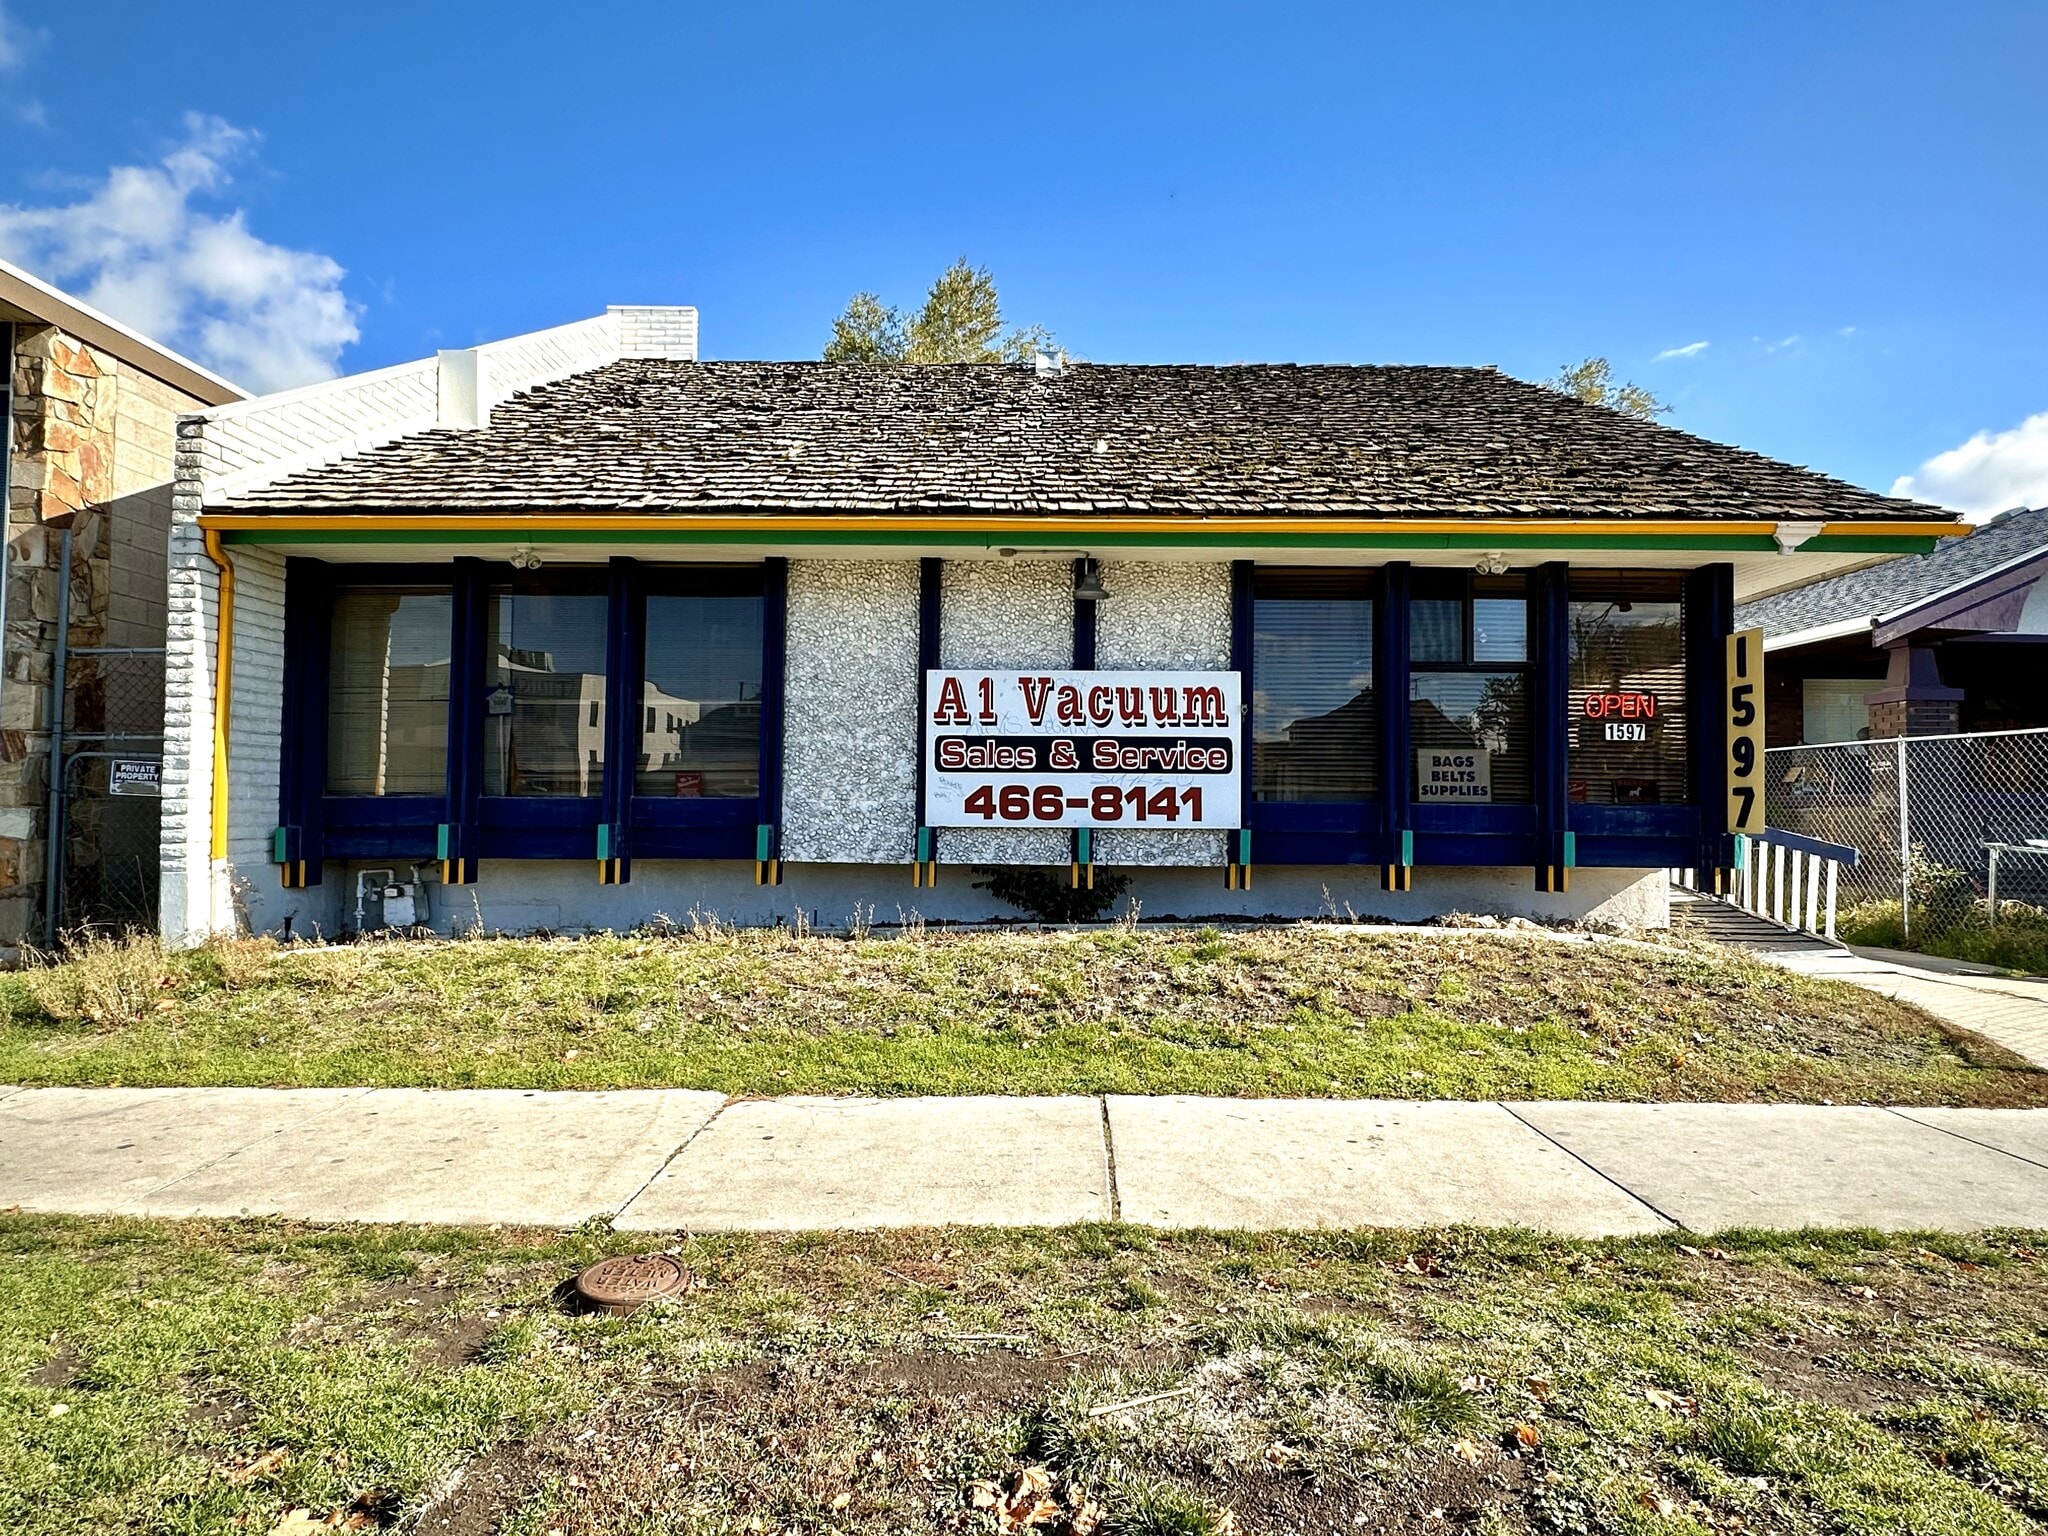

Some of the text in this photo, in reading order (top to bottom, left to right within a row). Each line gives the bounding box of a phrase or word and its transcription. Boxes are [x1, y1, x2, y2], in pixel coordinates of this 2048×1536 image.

[933, 676, 1229, 727] A1 Vacuum
[1586, 695, 1654, 717] OPEN
[1608, 724, 1644, 740] 1597
[940, 739, 1228, 770] Sales & Service
[1432, 756, 1475, 767] BAGS
[121, 764, 156, 773] PRIVATE
[115, 772, 159, 780] PROPERTY
[1431, 771, 1476, 782] BELTS
[1421, 785, 1489, 797] SUPPLIES
[964, 785, 1203, 821] 466-8141
